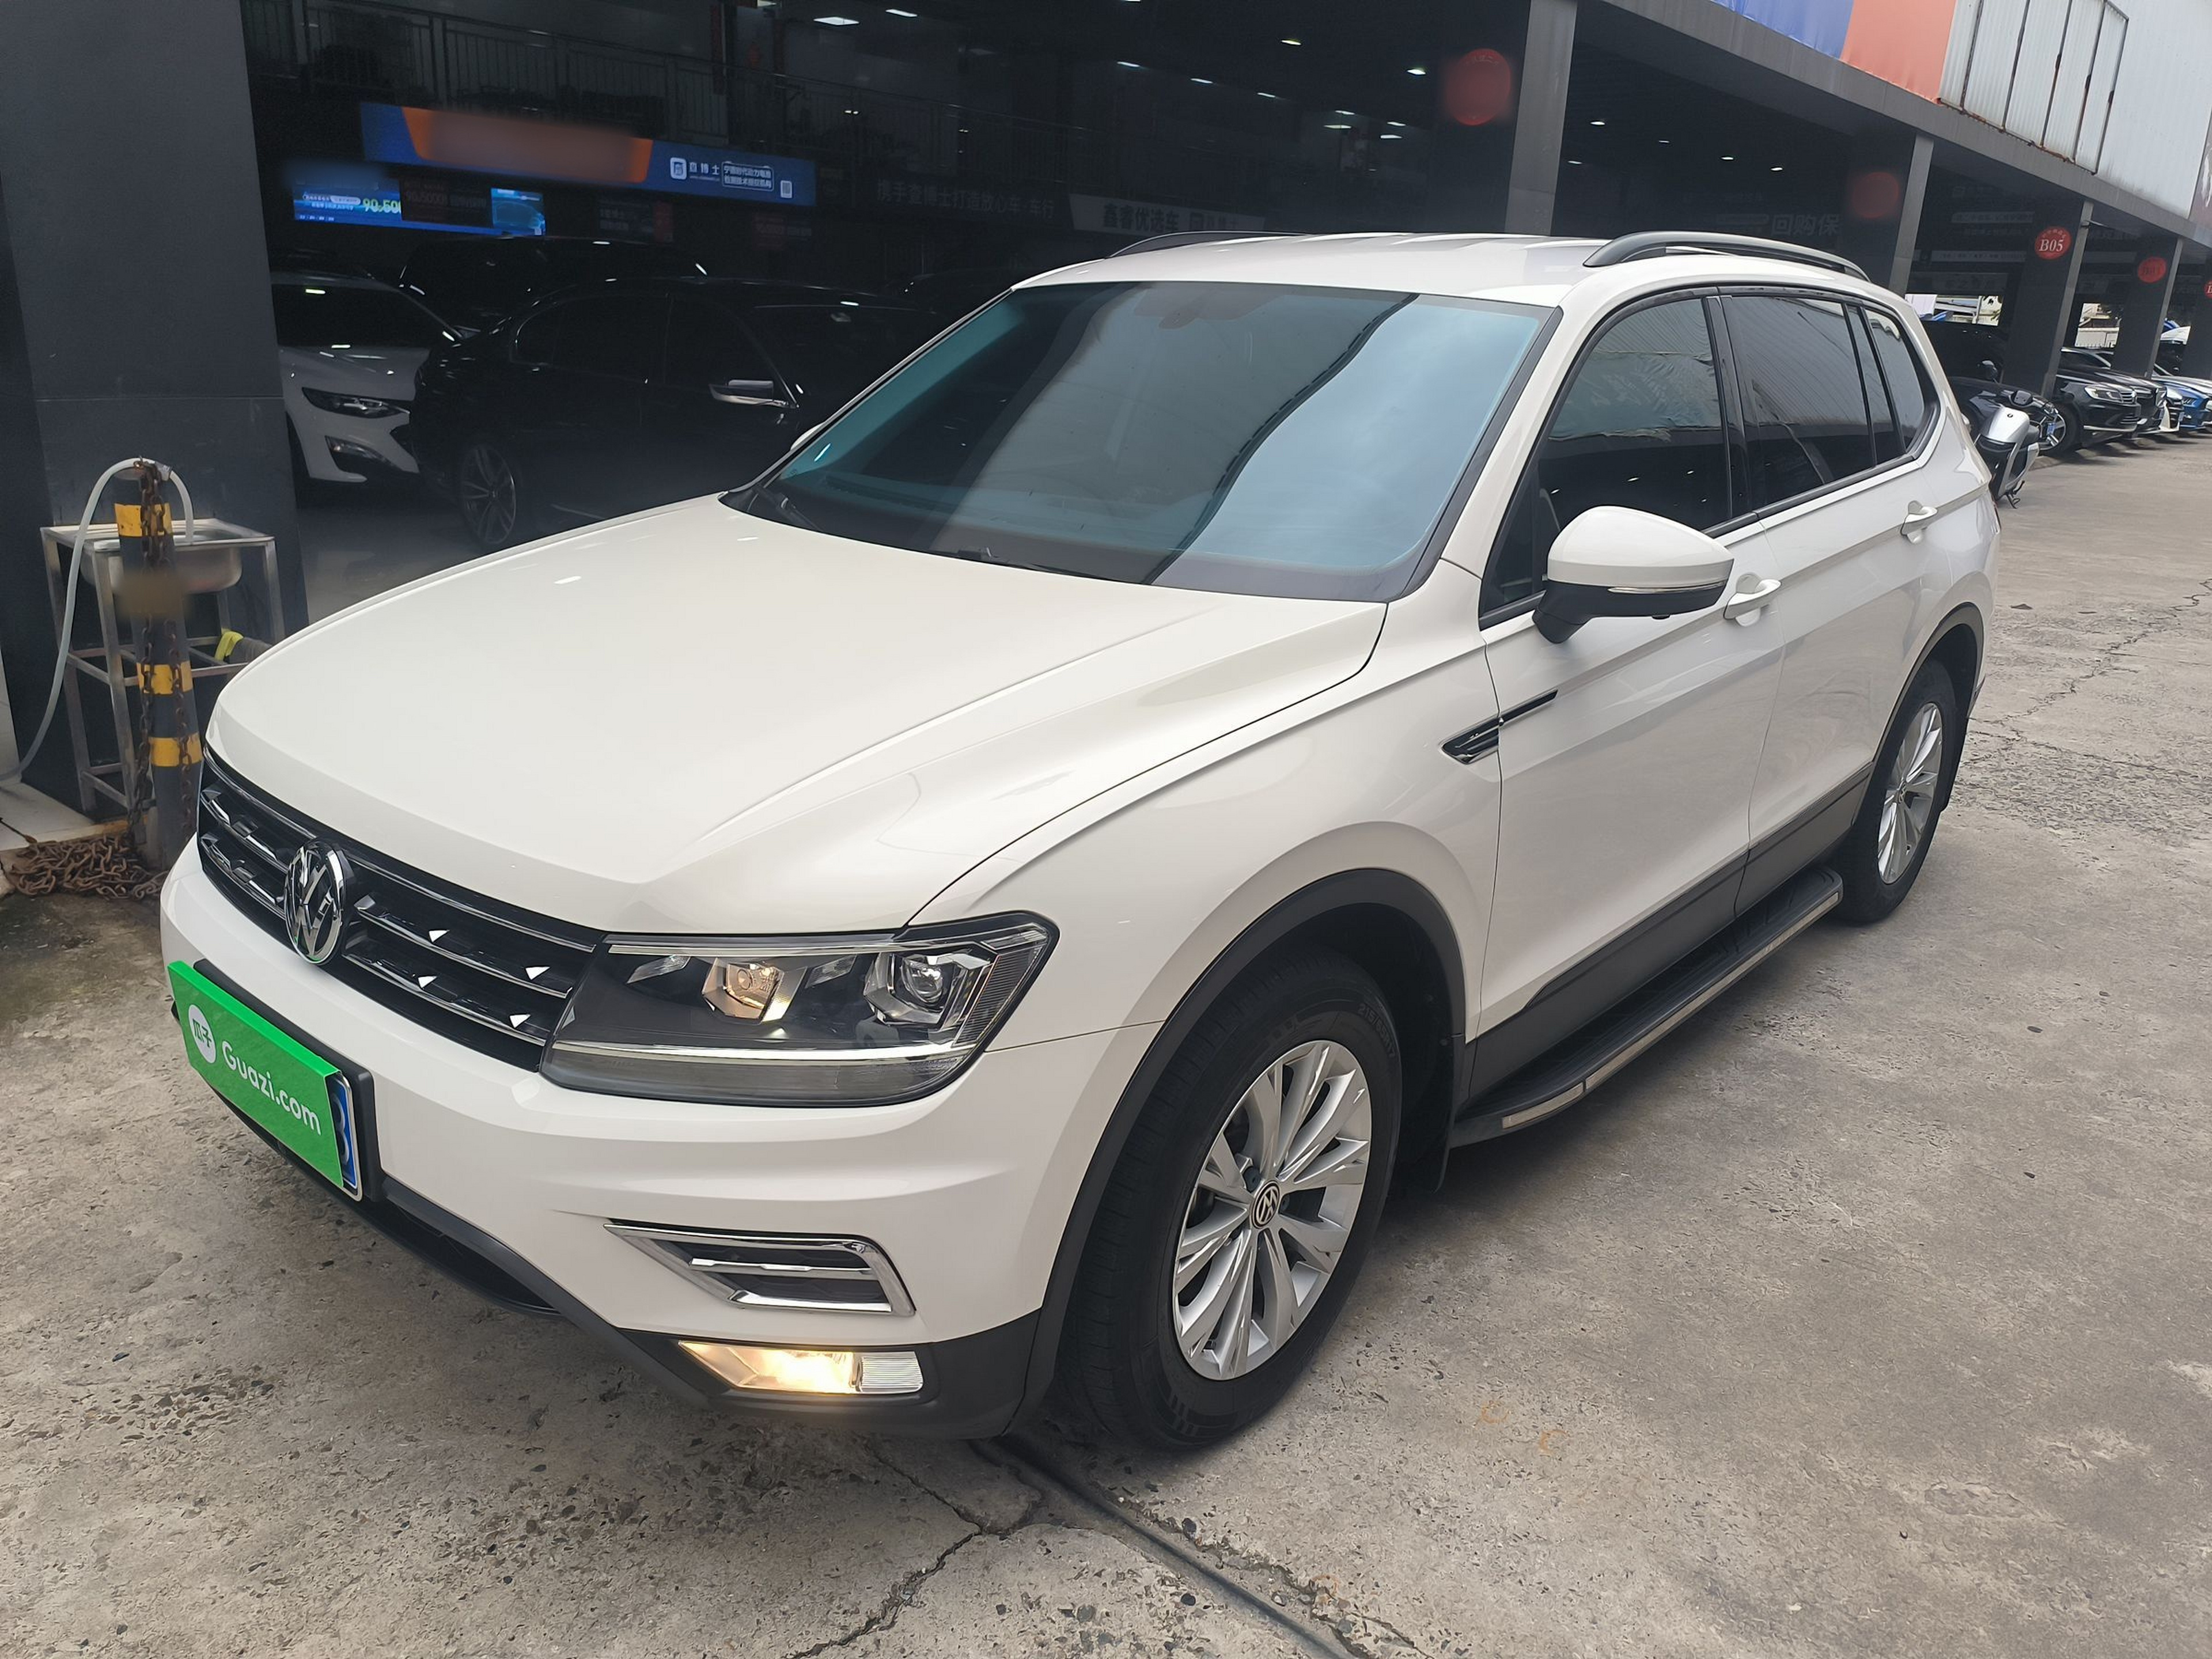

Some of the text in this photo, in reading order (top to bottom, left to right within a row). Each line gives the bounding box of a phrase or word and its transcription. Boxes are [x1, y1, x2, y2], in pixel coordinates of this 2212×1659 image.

[2038, 238, 2065, 252] B05
[192, 1018, 212, 1048] 瓜子
[221, 1040, 322, 1136] Guazi.com
